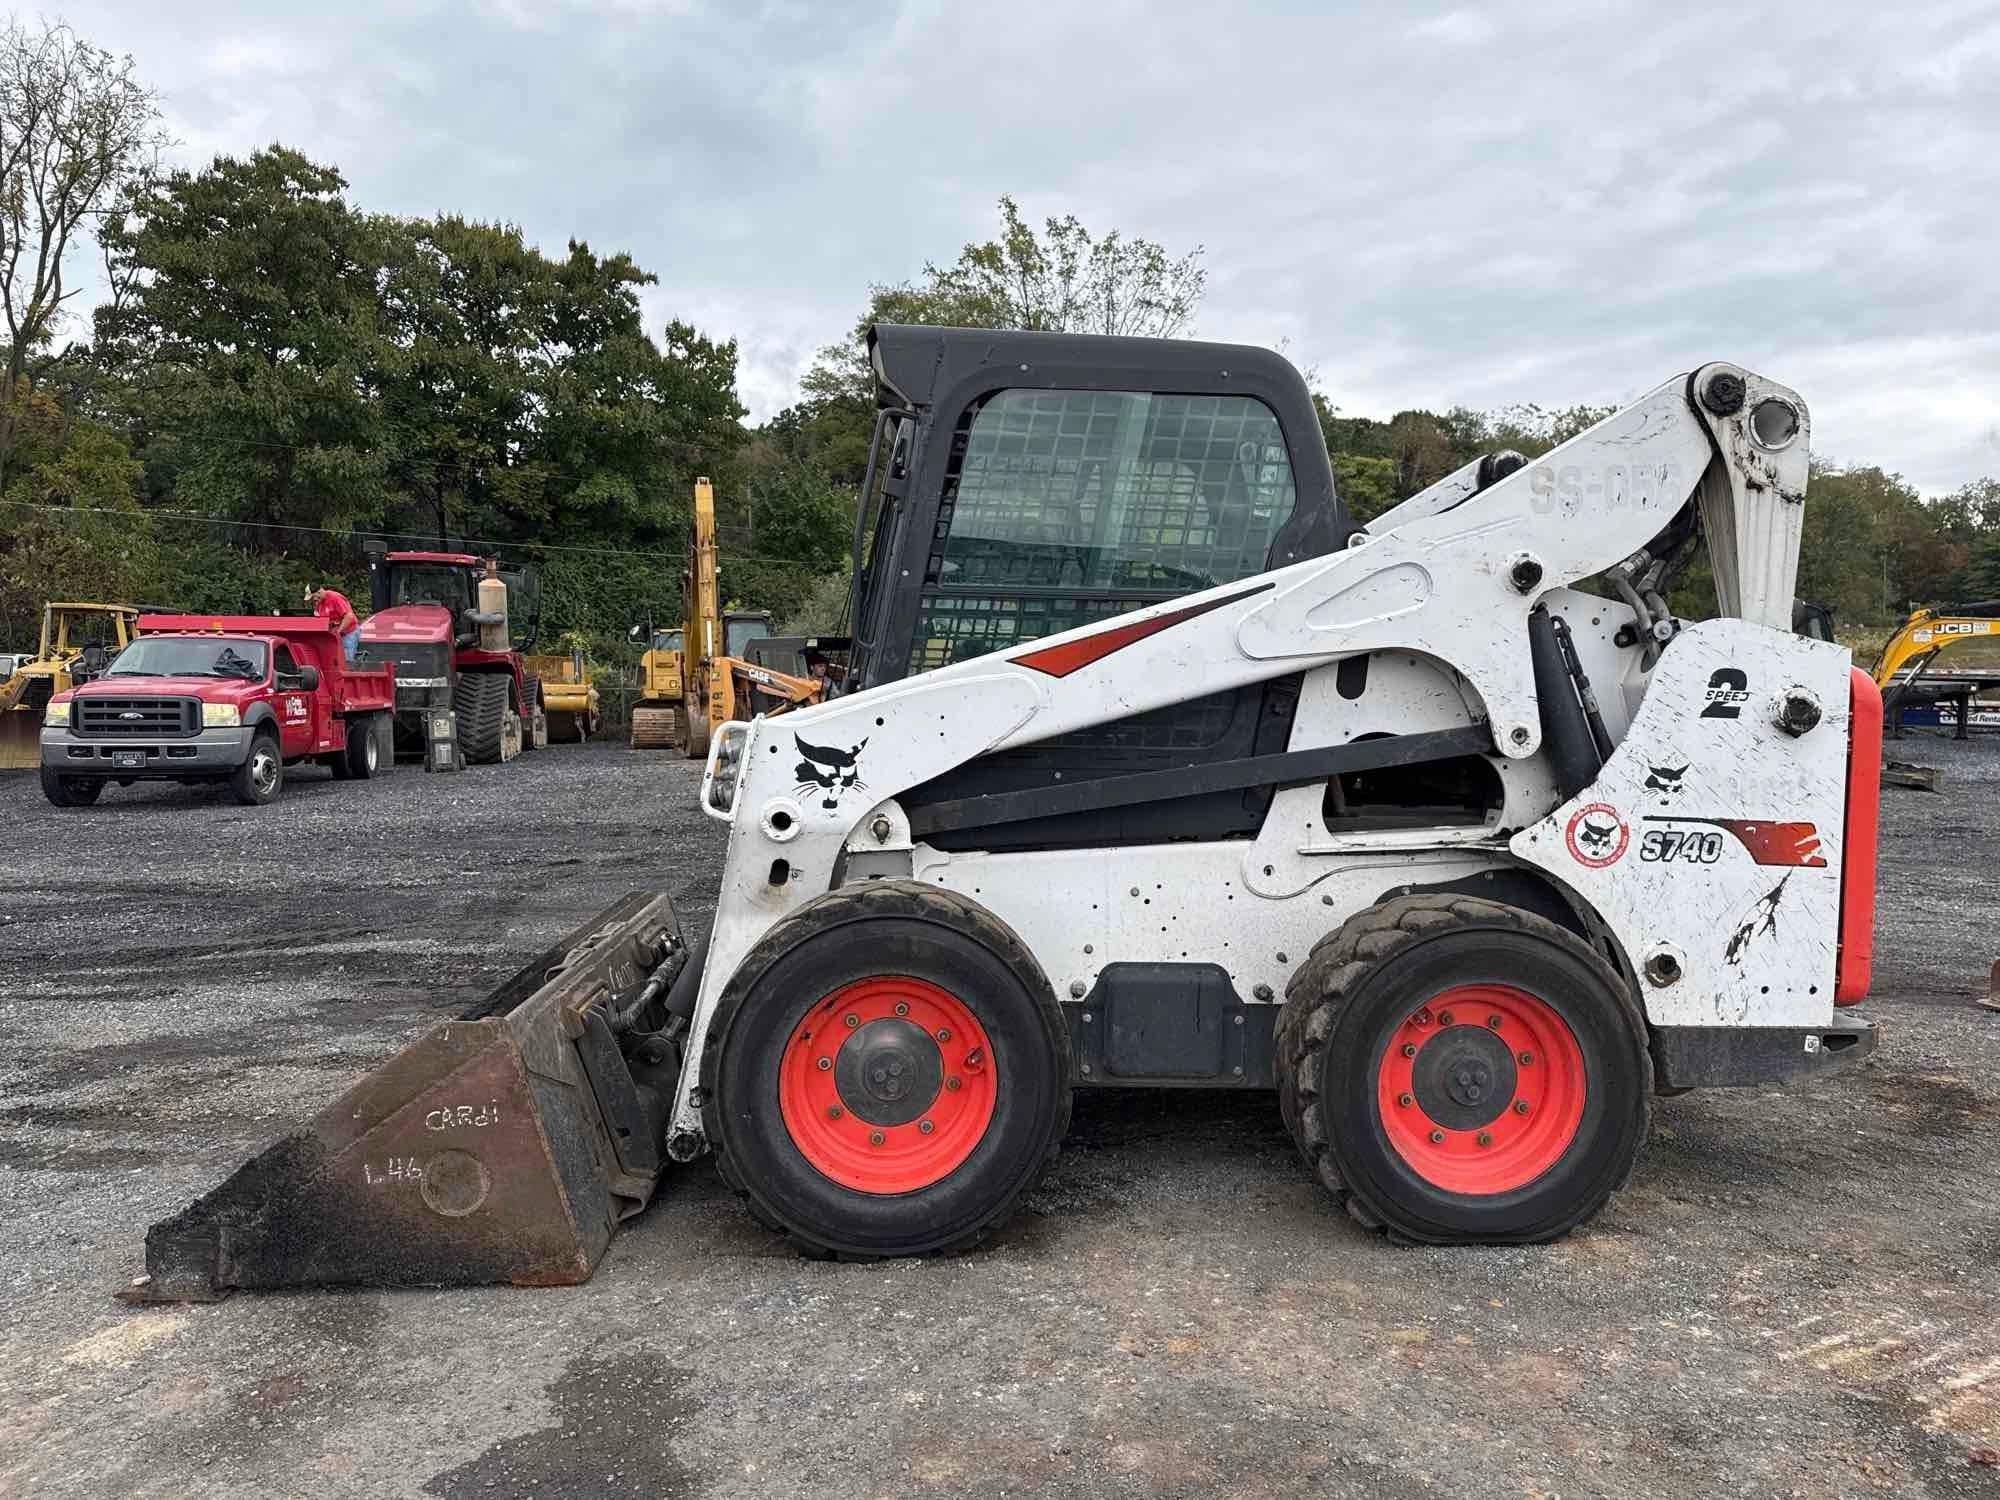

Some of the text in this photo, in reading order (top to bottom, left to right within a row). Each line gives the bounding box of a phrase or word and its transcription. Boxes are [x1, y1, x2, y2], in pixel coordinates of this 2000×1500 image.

[1934, 623, 1972, 634] JCB
[748, 668, 770, 683] CASE
[1700, 668, 1747, 719] 2
[1705, 690, 1751, 702] SPEED
[1639, 830, 1723, 864] S740
